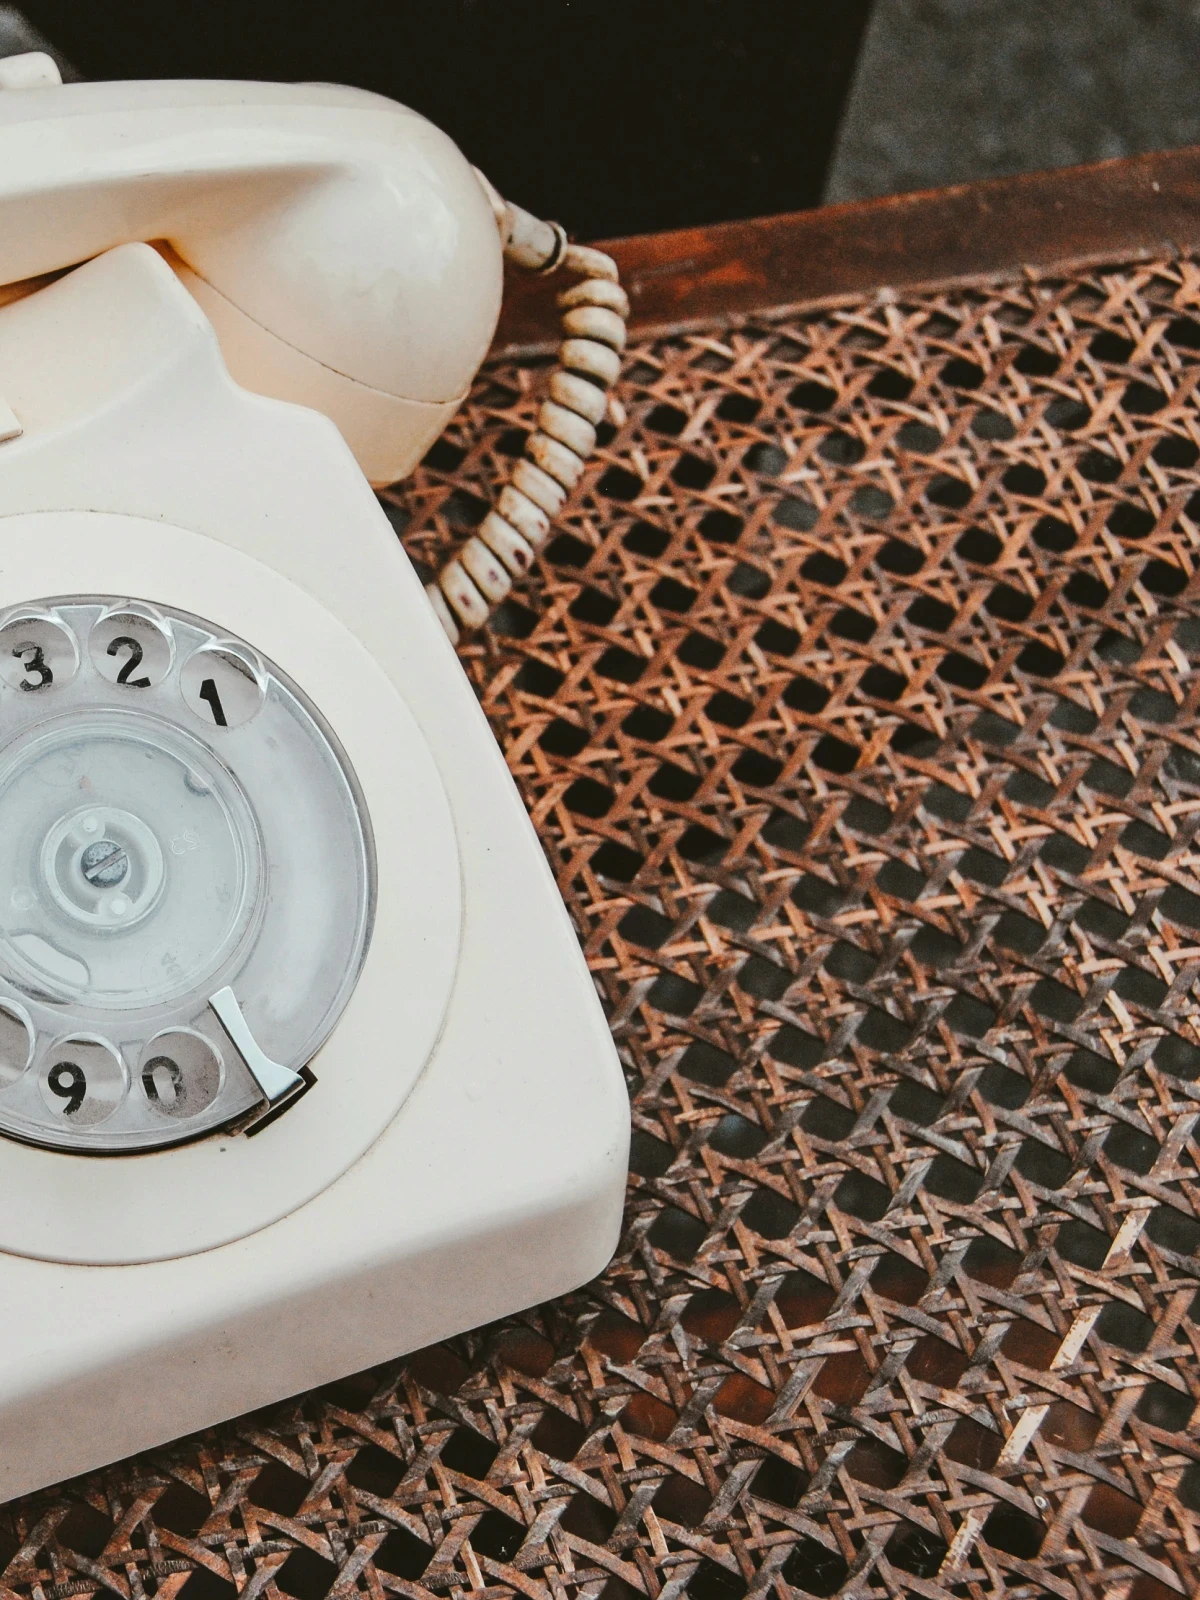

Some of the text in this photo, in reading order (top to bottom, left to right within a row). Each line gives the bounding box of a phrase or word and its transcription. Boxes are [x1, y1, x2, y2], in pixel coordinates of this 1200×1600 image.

[12, 641, 53, 692] 3
[106, 636, 151, 687] 2
[199, 678, 228, 727] 1
[47, 1061, 86, 1114] 9
[141, 1055, 184, 1108] 0
